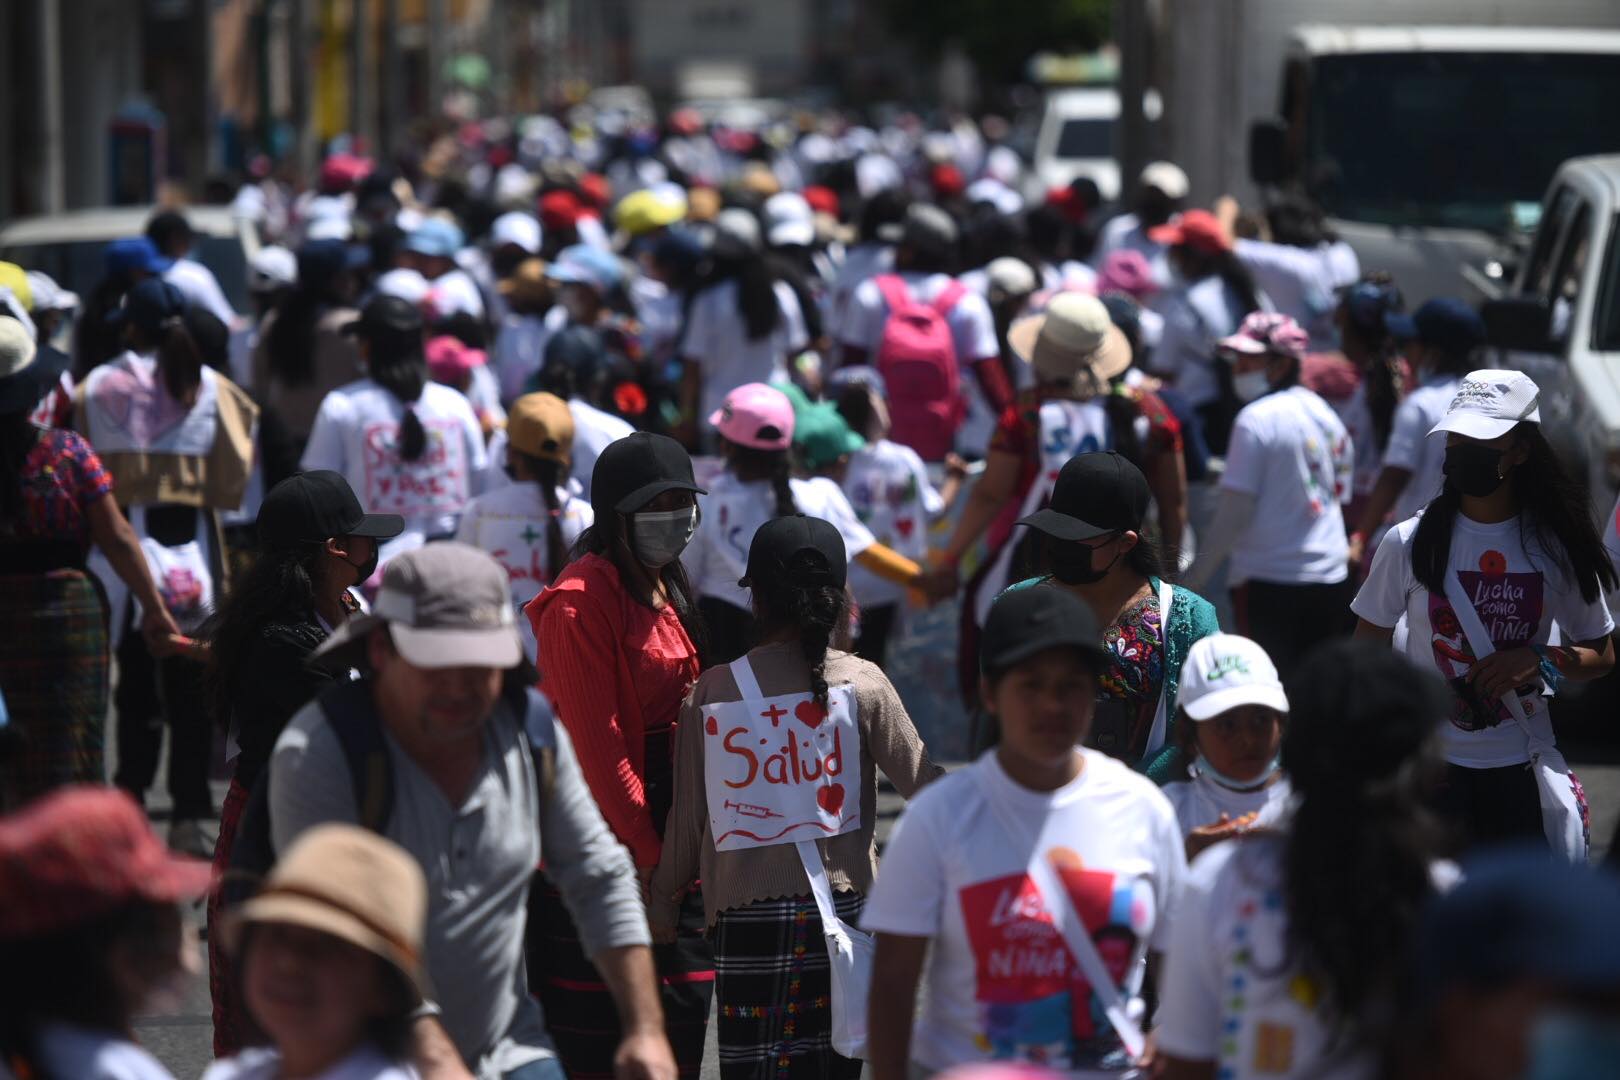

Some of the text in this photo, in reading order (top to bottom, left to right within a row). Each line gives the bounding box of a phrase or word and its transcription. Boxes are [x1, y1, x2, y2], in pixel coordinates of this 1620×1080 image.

[1474, 577, 1524, 606] Lucha
[1482, 601, 1517, 616] como
[723, 726, 843, 789] Salud
